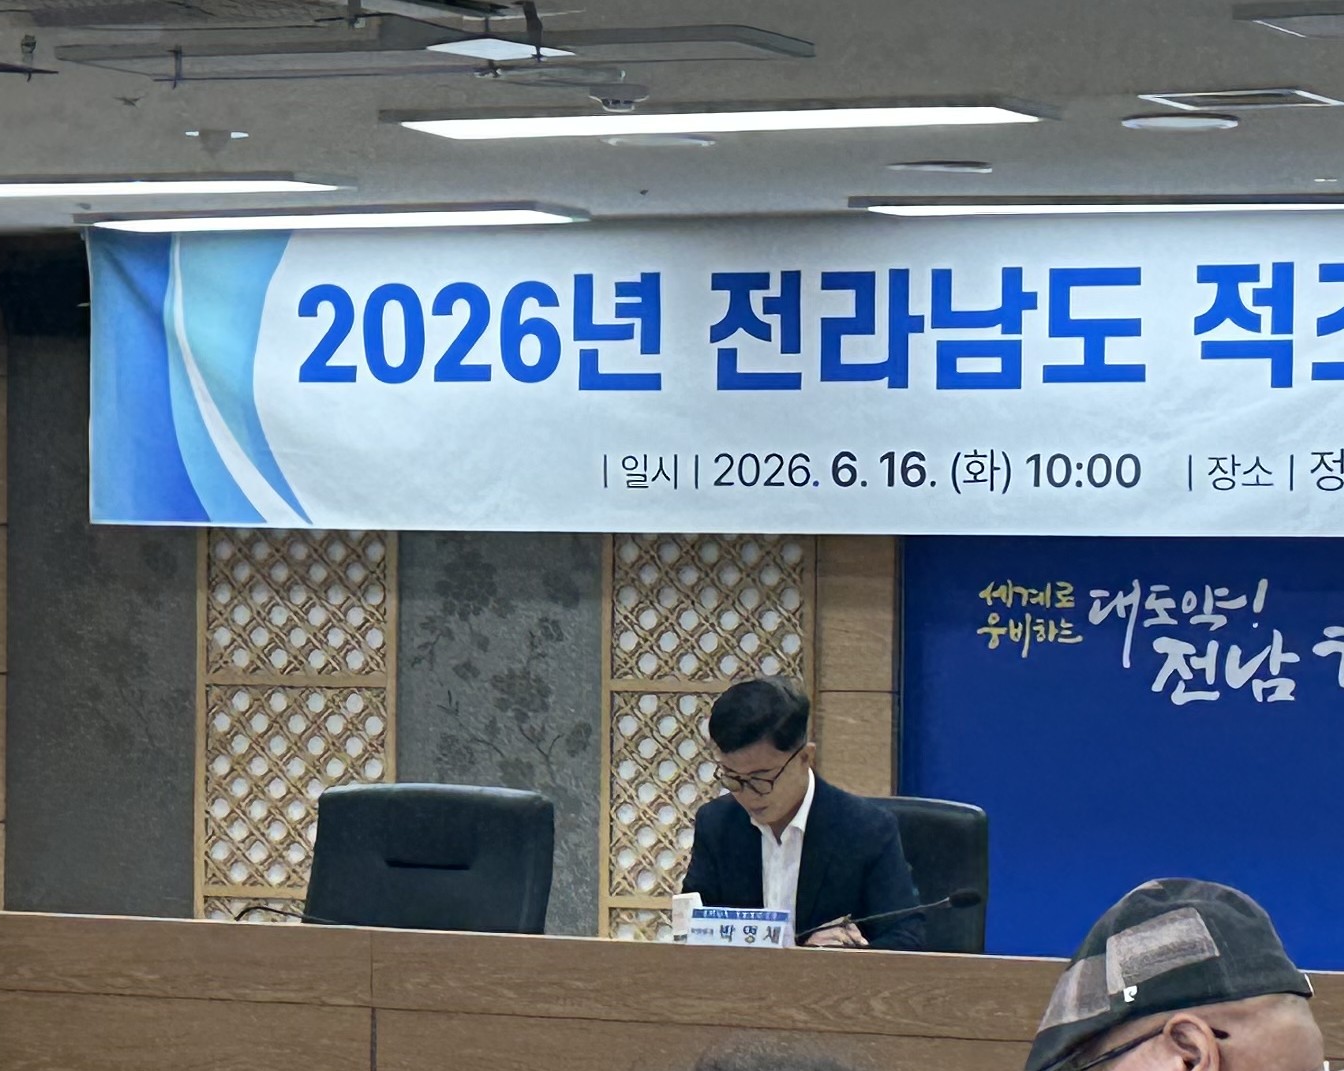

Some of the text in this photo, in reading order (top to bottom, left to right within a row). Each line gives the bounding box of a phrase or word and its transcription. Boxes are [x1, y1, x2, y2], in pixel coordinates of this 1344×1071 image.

[298, 272, 662, 390] 2026년
[709, 265, 1146, 390] 전라남도
[621, 453, 678, 490] 일시
[713, 452, 819, 488] 2026.
[831, 451, 868, 488] 6.
[879, 451, 937, 488] 16.
[950, 449, 1011, 495] (화)
[1026, 453, 1141, 489] 10:00
[1208, 454, 1273, 491] 장소
[978, 579, 1076, 609] 세계로
[976, 612, 1084, 659] 웅비하는
[1151, 629, 1301, 706] 전남
